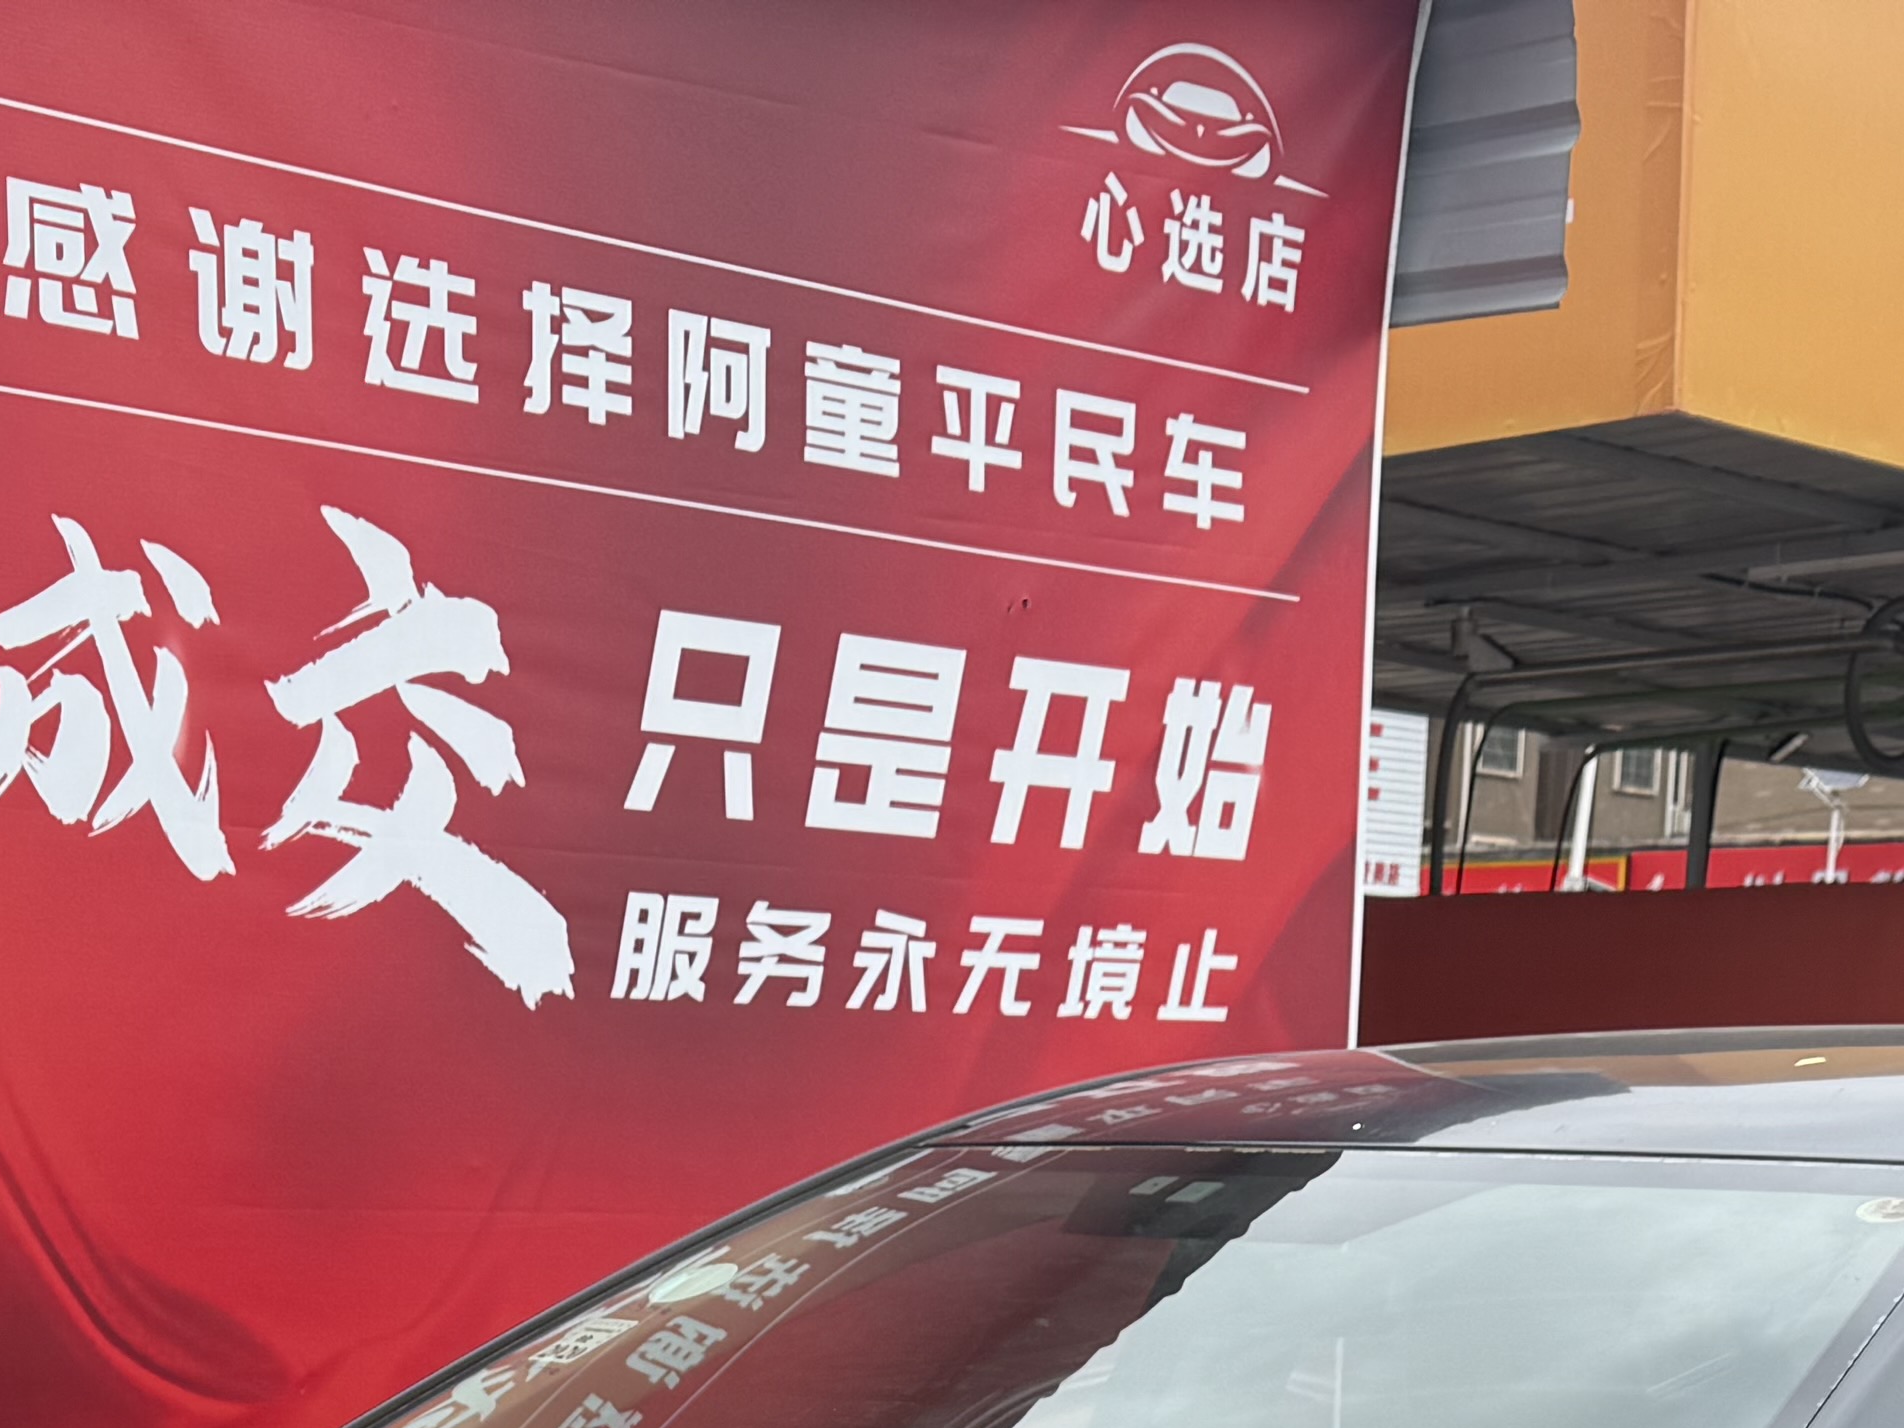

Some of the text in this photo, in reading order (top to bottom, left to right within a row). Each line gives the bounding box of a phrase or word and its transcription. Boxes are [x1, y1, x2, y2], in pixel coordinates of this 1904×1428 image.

[1080, 171, 1306, 312] 心选店
[3, 176, 1247, 529] 感谢选择阿童平民车
[624, 609, 1272, 861] 只是开始
[611, 892, 1239, 1021] 服务永无境止
